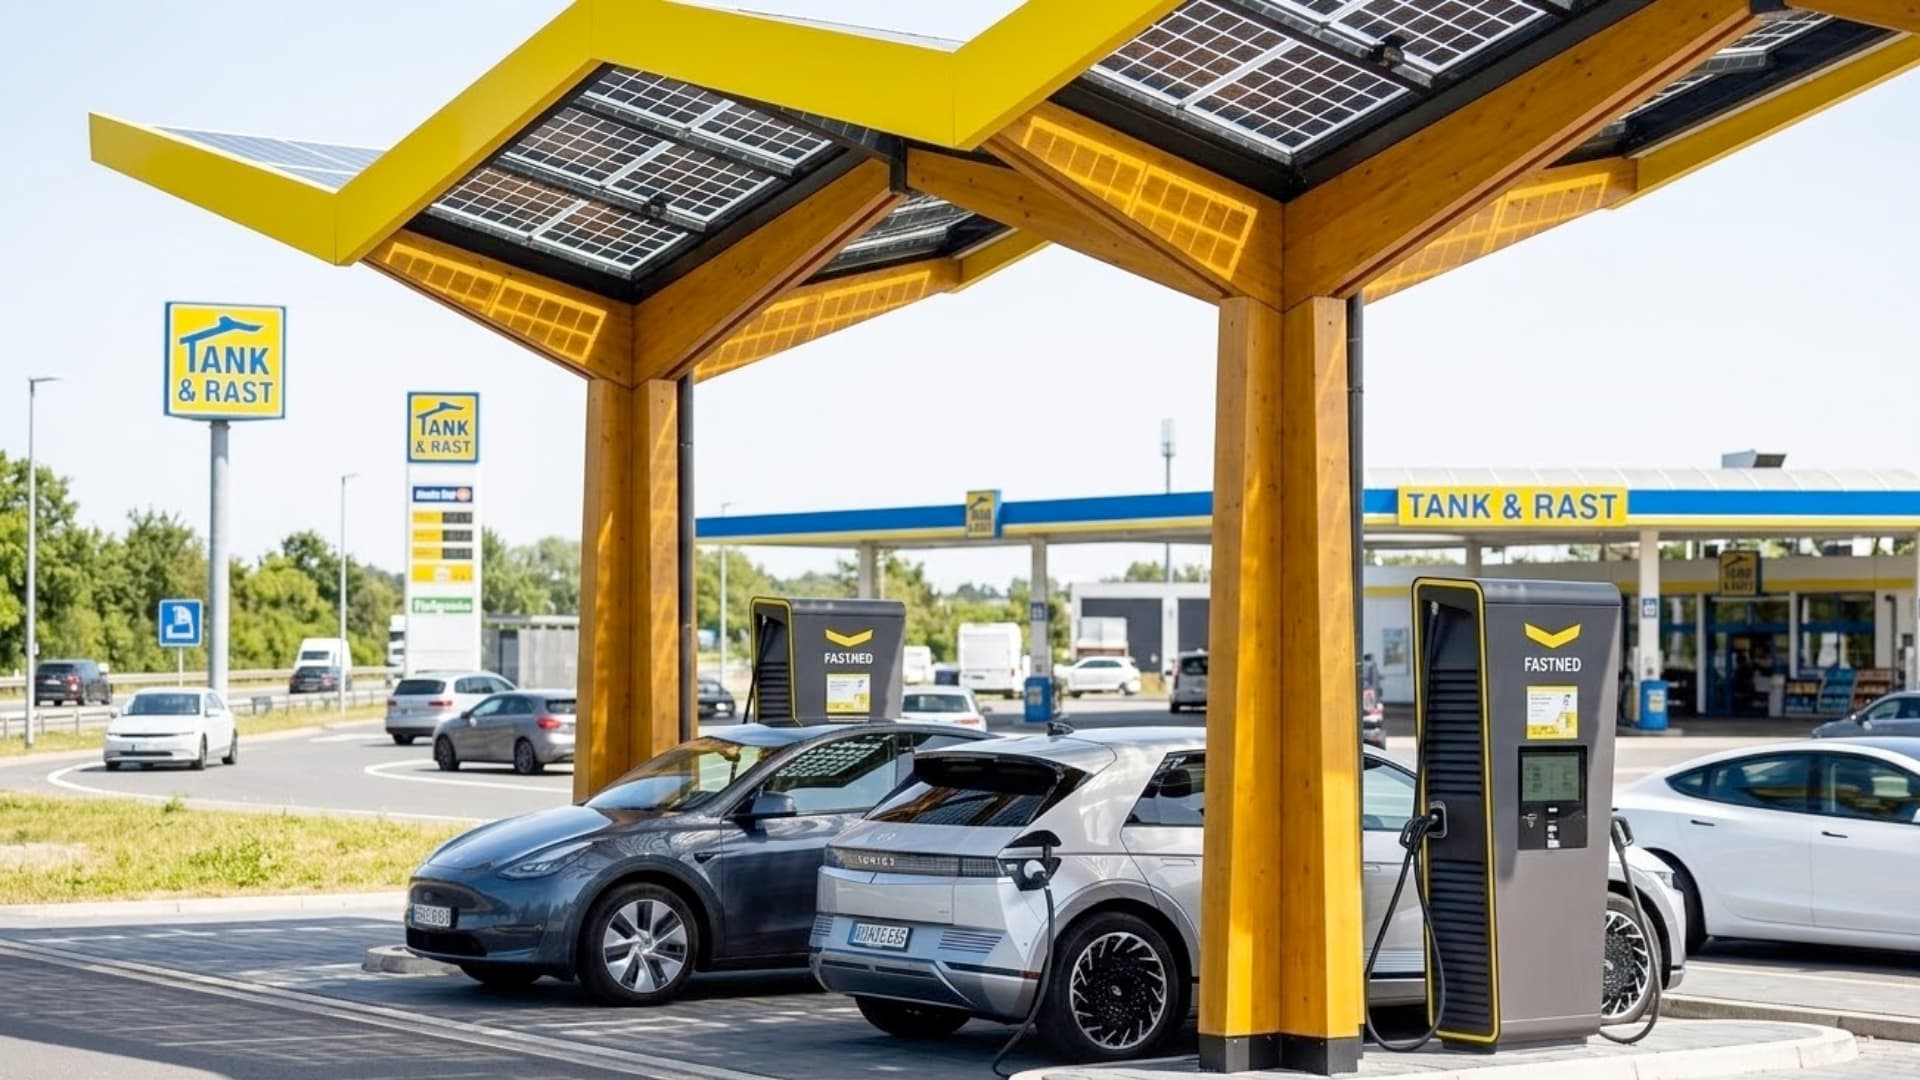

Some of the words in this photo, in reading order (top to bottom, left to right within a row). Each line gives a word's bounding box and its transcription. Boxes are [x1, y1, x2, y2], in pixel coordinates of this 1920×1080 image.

[179, 326, 270, 375] TANK
[178, 378, 196, 402] &
[205, 379, 273, 404] RAST
[416, 408, 469, 436] TANK
[431, 440, 471, 454] RAST
[1407, 493, 1491, 519] TANK
[1502, 493, 1522, 520] &
[1534, 493, 1618, 520] RAST
[1524, 656, 1582, 672] FASTNED
